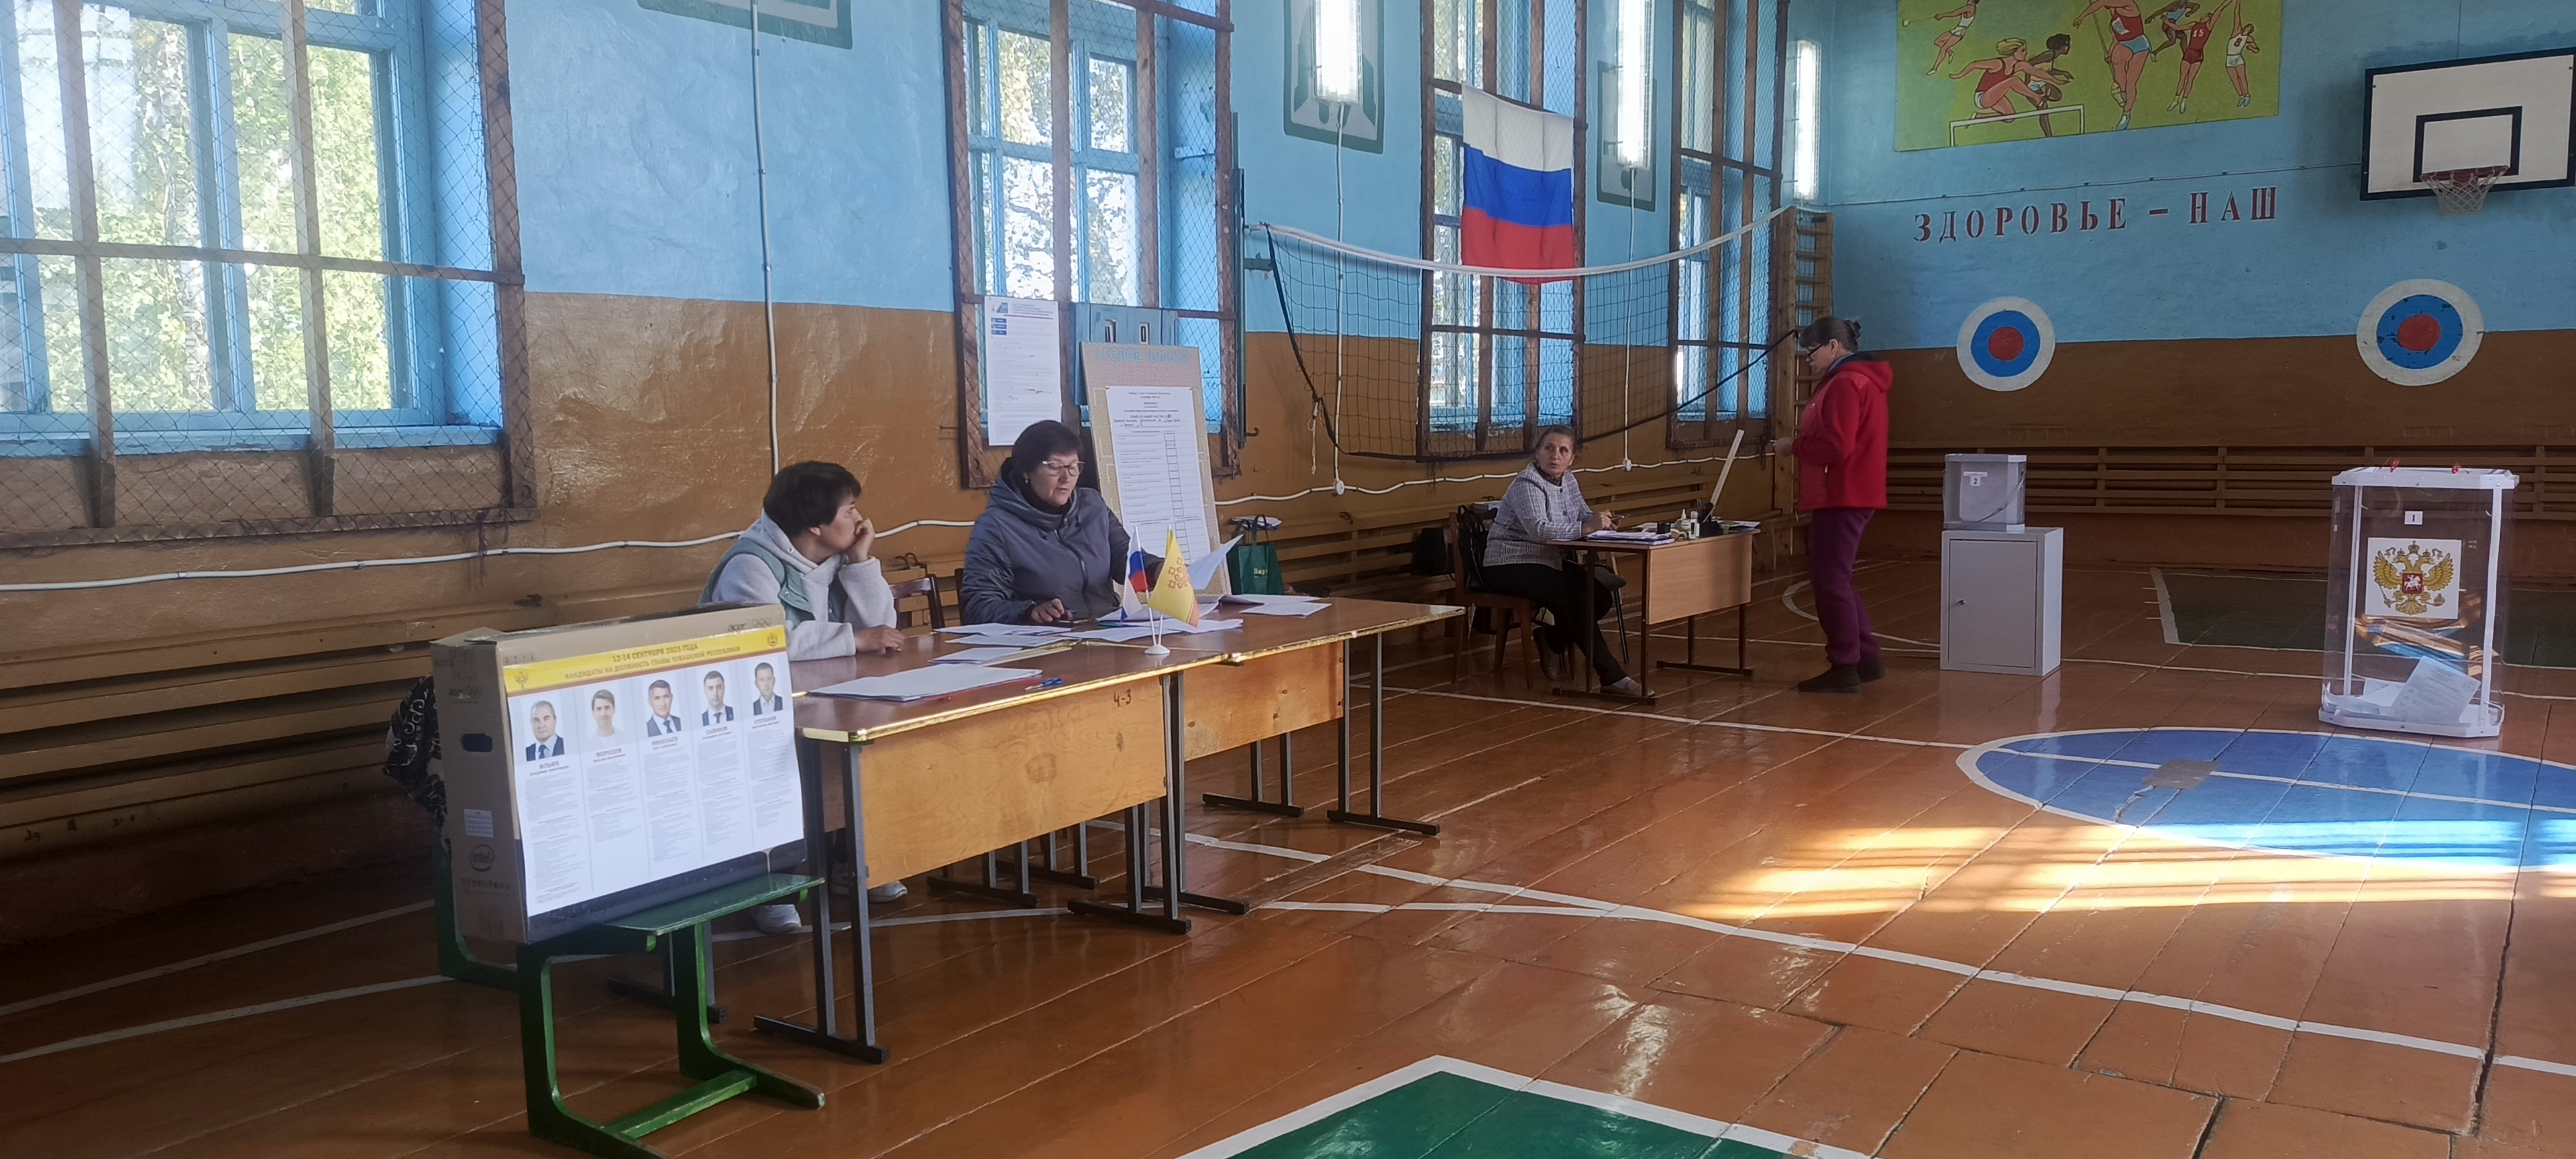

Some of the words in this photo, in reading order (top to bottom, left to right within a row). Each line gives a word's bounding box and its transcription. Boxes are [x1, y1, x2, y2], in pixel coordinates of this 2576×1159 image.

[2192, 28, 2204, 37] 15
[2233, 38, 2242, 47] 8
[1913, 198, 2127, 243] ЗДОРОВЬЕ
[2189, 187, 2277, 224] НАШ
[728, 622, 747, 632] acer
[632, 649, 664, 659] СЕНТЯБРЯ
[682, 644, 699, 652] ГОДА
[565, 667, 604, 679] КАНДИДАТЫ
[614, 661, 650, 672] ДОЛЖНОСТЬ
[651, 657, 671, 665] ГЛАВЫ
[671, 651, 706, 663] ЧУВАШСКОЙ
[706, 646, 741, 657] РЕСПУБЛИКИ
[754, 716, 777, 725] СТЕПАНОВ
[596, 748, 623, 758] МОРОЗОВ
[539, 761, 559, 769] ИЛЬИН
